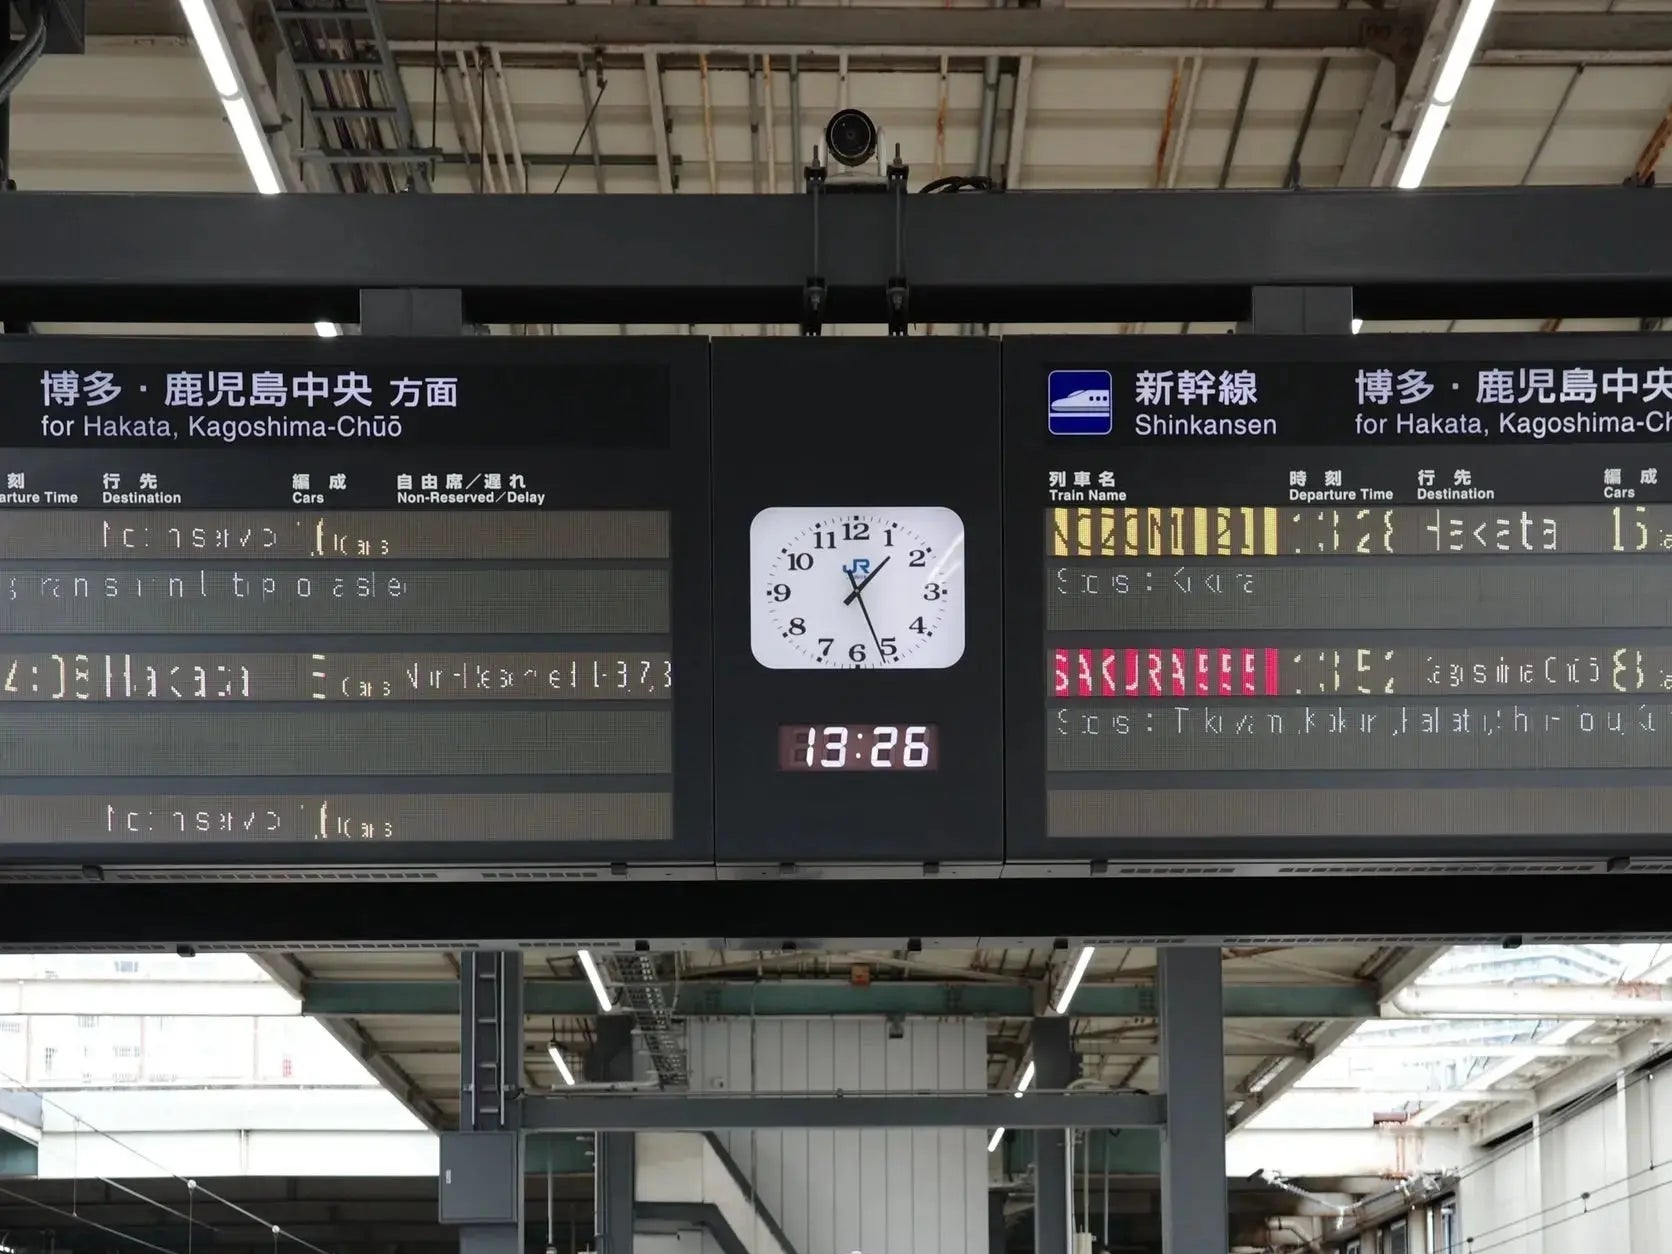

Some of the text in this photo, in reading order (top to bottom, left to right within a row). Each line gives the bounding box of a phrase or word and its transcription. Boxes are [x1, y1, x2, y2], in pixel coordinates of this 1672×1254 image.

[389, 377, 458, 407] 方面
[1135, 369, 1258, 406] 新幹線
[41, 414, 402, 442] for Hakata, Kagoshima-Chūō
[1135, 413, 1277, 435] Shinkansen
[1355, 413, 1388, 435] for
[1397, 412, 1489, 437] Hakata,
[7, 472, 25, 490] 刻
[1048, 470, 1116, 487] 列車名
[44, 491, 79, 504] Time
[102, 491, 182, 504] Destination
[292, 491, 325, 504] Cars
[1048, 489, 1127, 501] Train Name
[1289, 488, 1394, 504] Departure Time
[1417, 487, 1495, 500] Destination
[1603, 486, 1636, 499] Cars
[814, 531, 838, 549] 11
[842, 522, 870, 541] 12
[883, 529, 894, 547] 1
[787, 552, 814, 571] 10
[842, 558, 871, 574] JR
[908, 549, 927, 568] 2
[772, 583, 792, 603] 9
[923, 582, 941, 601] 3
[788, 617, 807, 636] 8
[908, 616, 928, 635] 4
[818, 638, 835, 657] 7
[848, 643, 867, 663] 6
[881, 636, 898, 656] 5
[805, 726, 929, 768] 13:26
